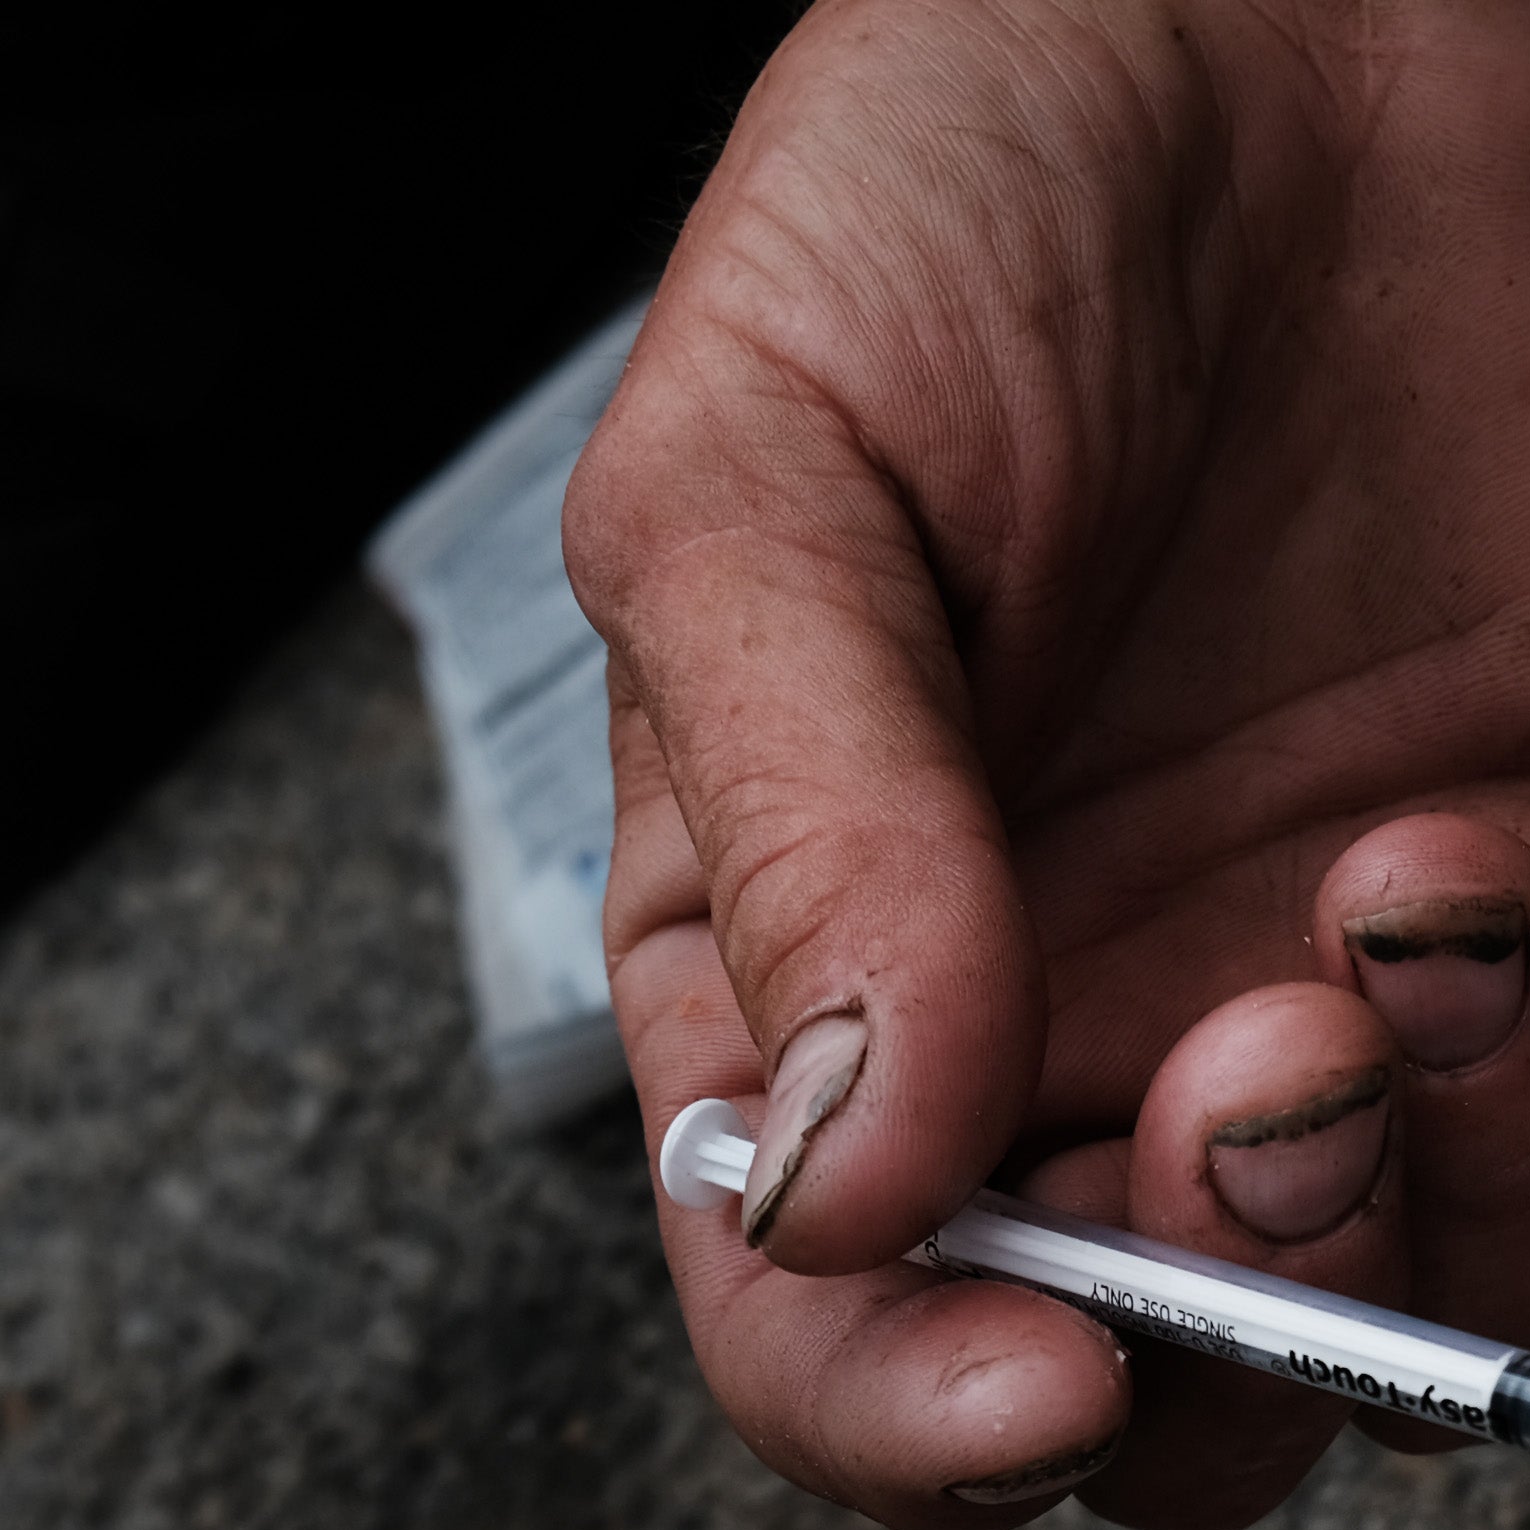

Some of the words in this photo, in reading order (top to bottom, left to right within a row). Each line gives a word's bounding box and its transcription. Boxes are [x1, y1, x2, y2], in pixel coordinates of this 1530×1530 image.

[1090, 1282, 1134, 1312] ONLY
[1140, 1297, 1171, 1324] USE
[1177, 1309, 1237, 1344] SINGLE
